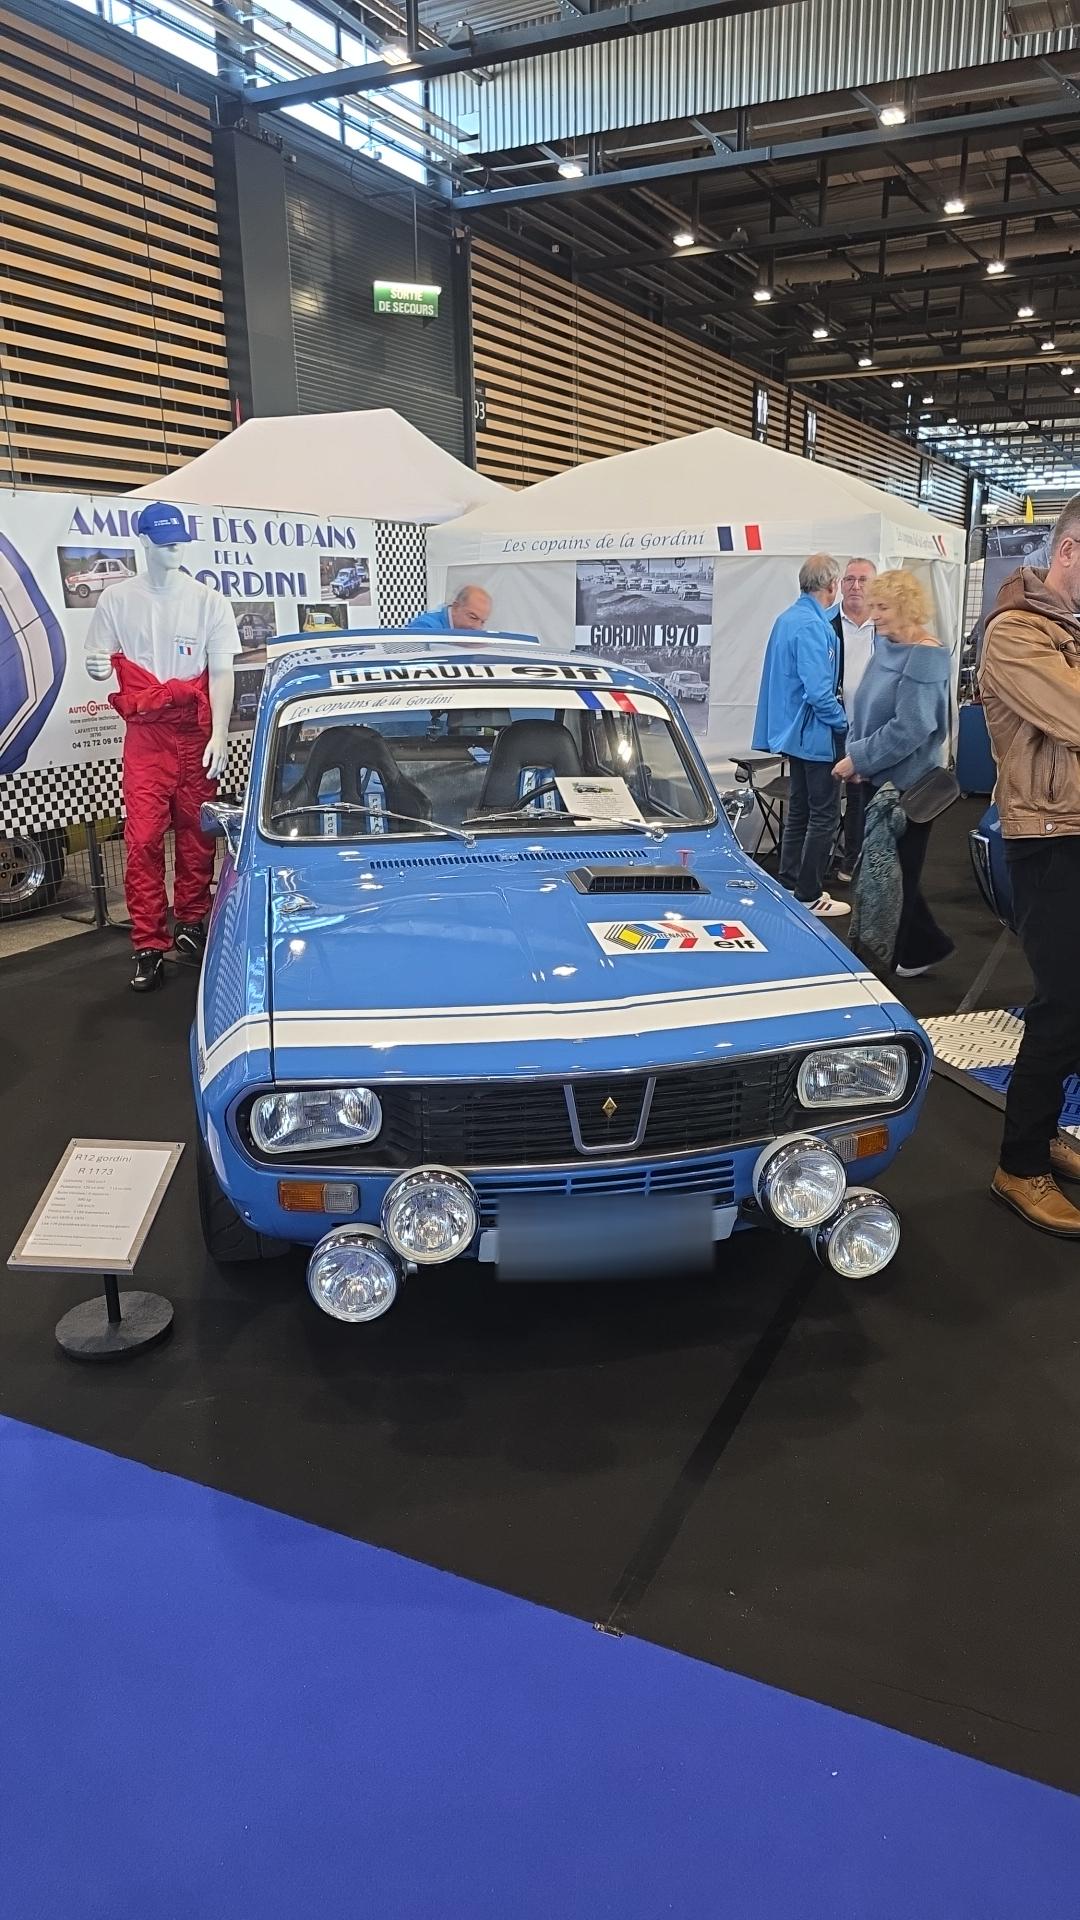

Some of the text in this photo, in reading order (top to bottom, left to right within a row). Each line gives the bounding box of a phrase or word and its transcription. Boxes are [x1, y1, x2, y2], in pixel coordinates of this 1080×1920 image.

[390, 289, 424, 301] SORTIE
[379, 301, 434, 316] DE SECOURS
[213, 517, 257, 544] DES
[264, 520, 357, 550] COPAINS
[502, 529, 706, 555] Les copains de la Gordini
[214, 550, 253, 565] DE LA
[178, 565, 308, 597] ORDINI
[590, 624, 699, 646] GORDINI 1970
[335, 664, 600, 684] RENAULT elf
[288, 693, 455, 721] Les copains de la Gordini
[75, 726, 99, 734] LAFAYETTE
[92, 739, 101, 747] 72
[713, 939, 757, 949] elf
[75, 1153, 132, 1163] R12 gordini
[78, 1167, 113, 1176] R 1173
